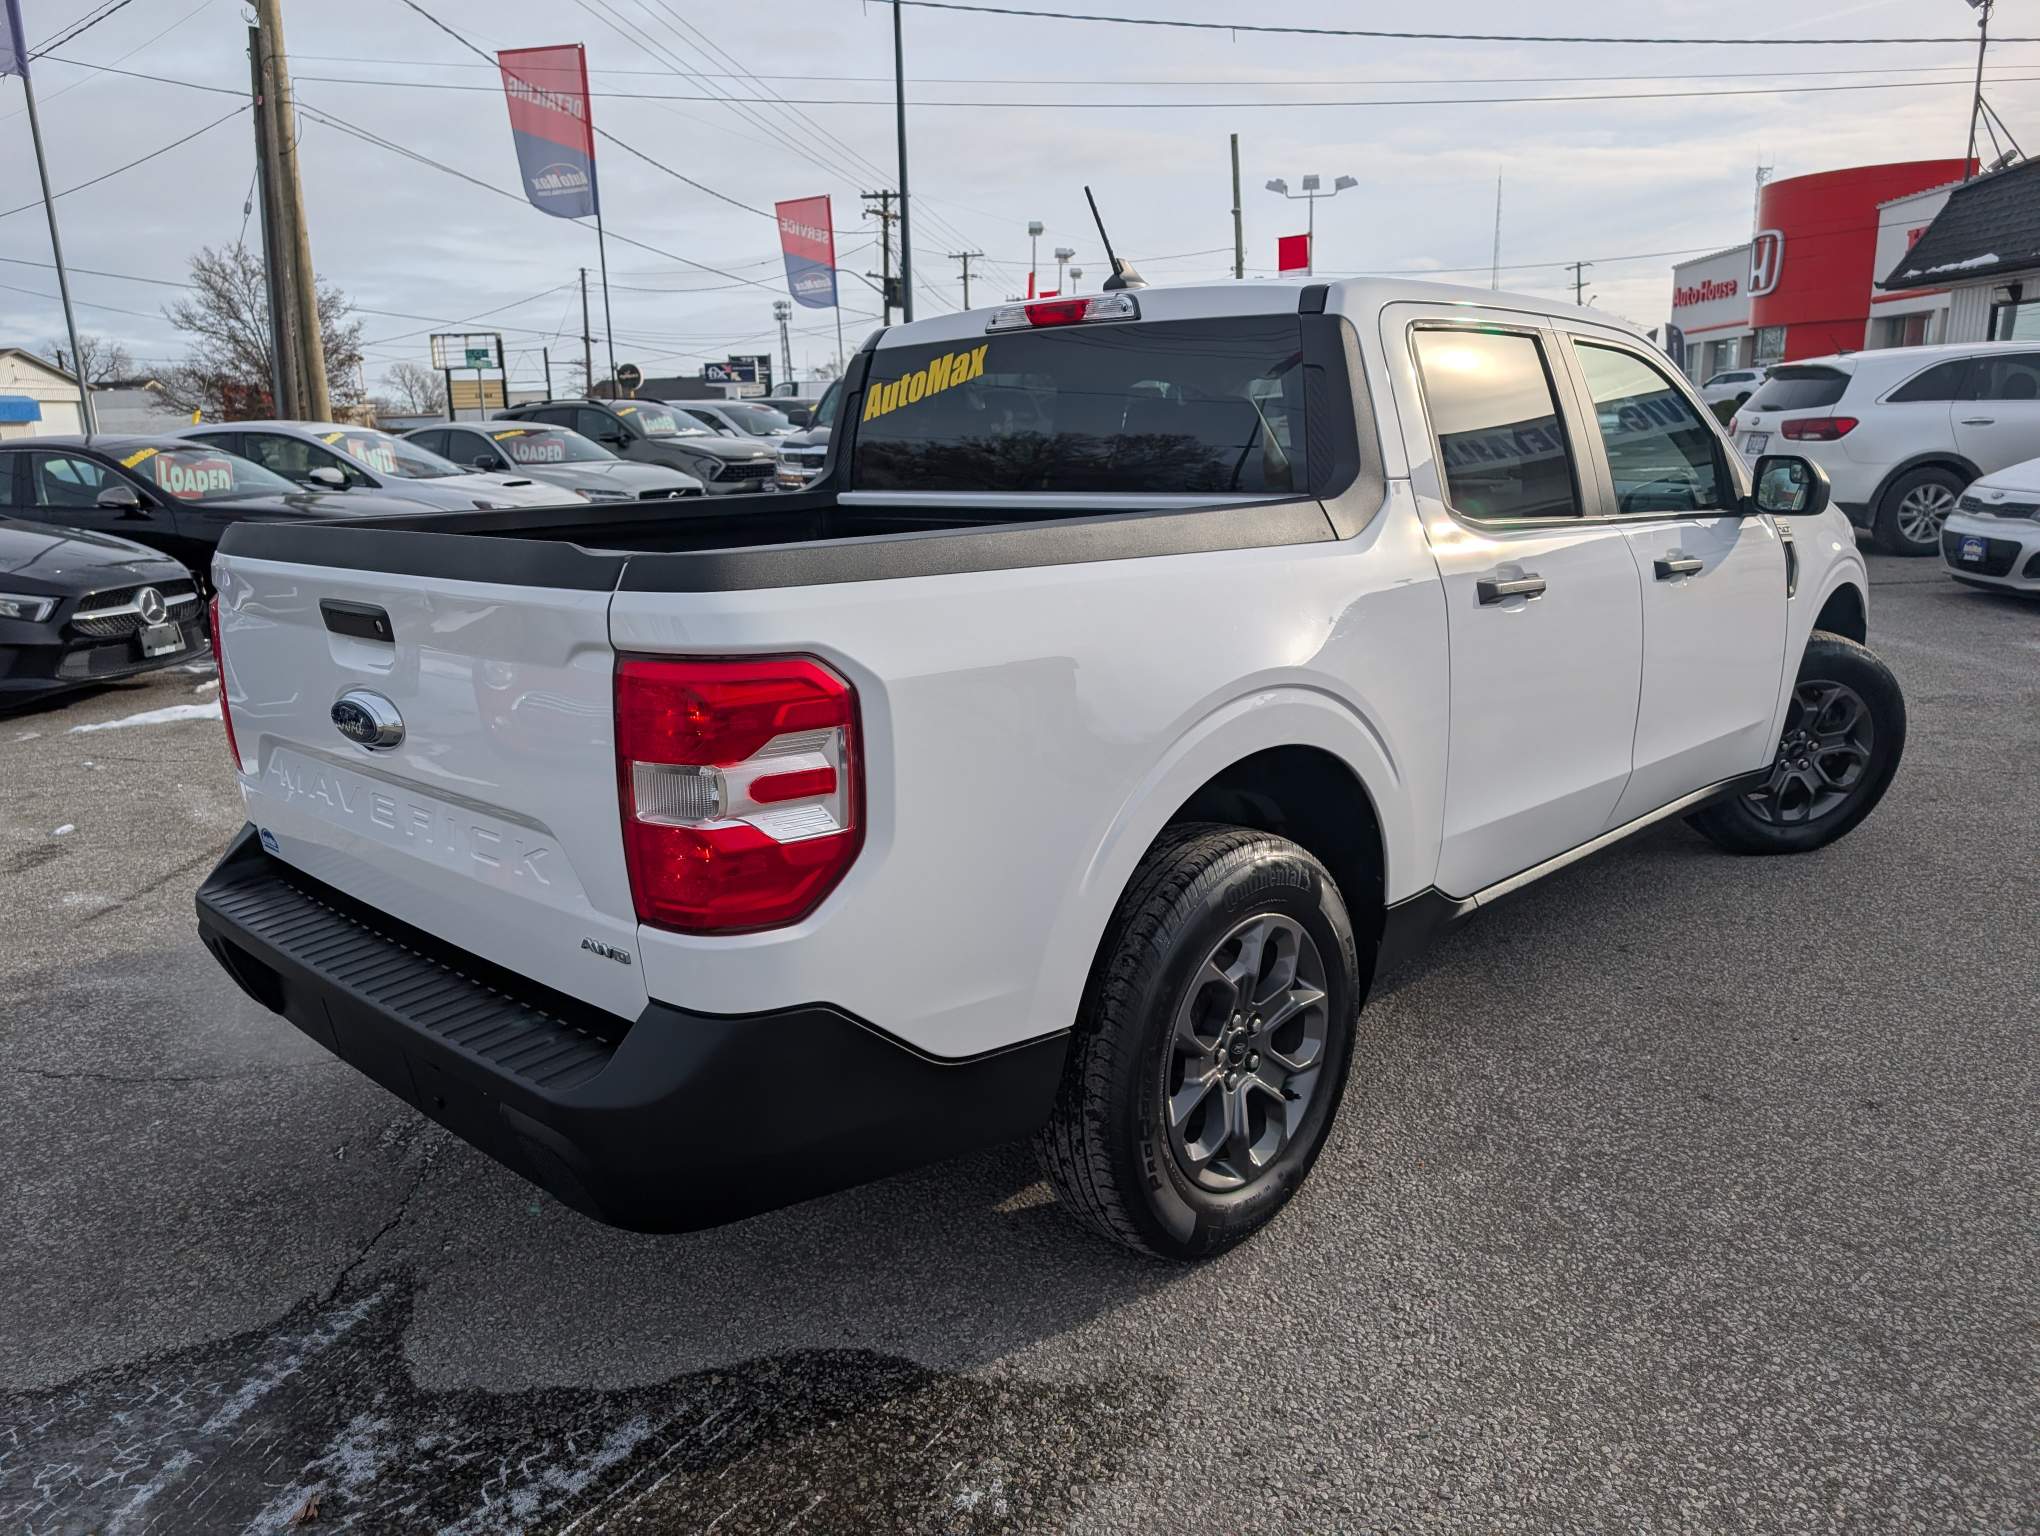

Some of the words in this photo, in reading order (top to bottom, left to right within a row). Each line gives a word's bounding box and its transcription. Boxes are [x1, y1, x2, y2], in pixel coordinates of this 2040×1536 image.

[1673, 286, 1700, 308] Auto
[1700, 279, 1738, 302] House
[863, 343, 989, 422] AutoMax
[512, 441, 563, 462] LOADED
[159, 460, 232, 495] LOADED
[261, 746, 551, 886] MAVERICK
[581, 937, 632, 965] AWD
